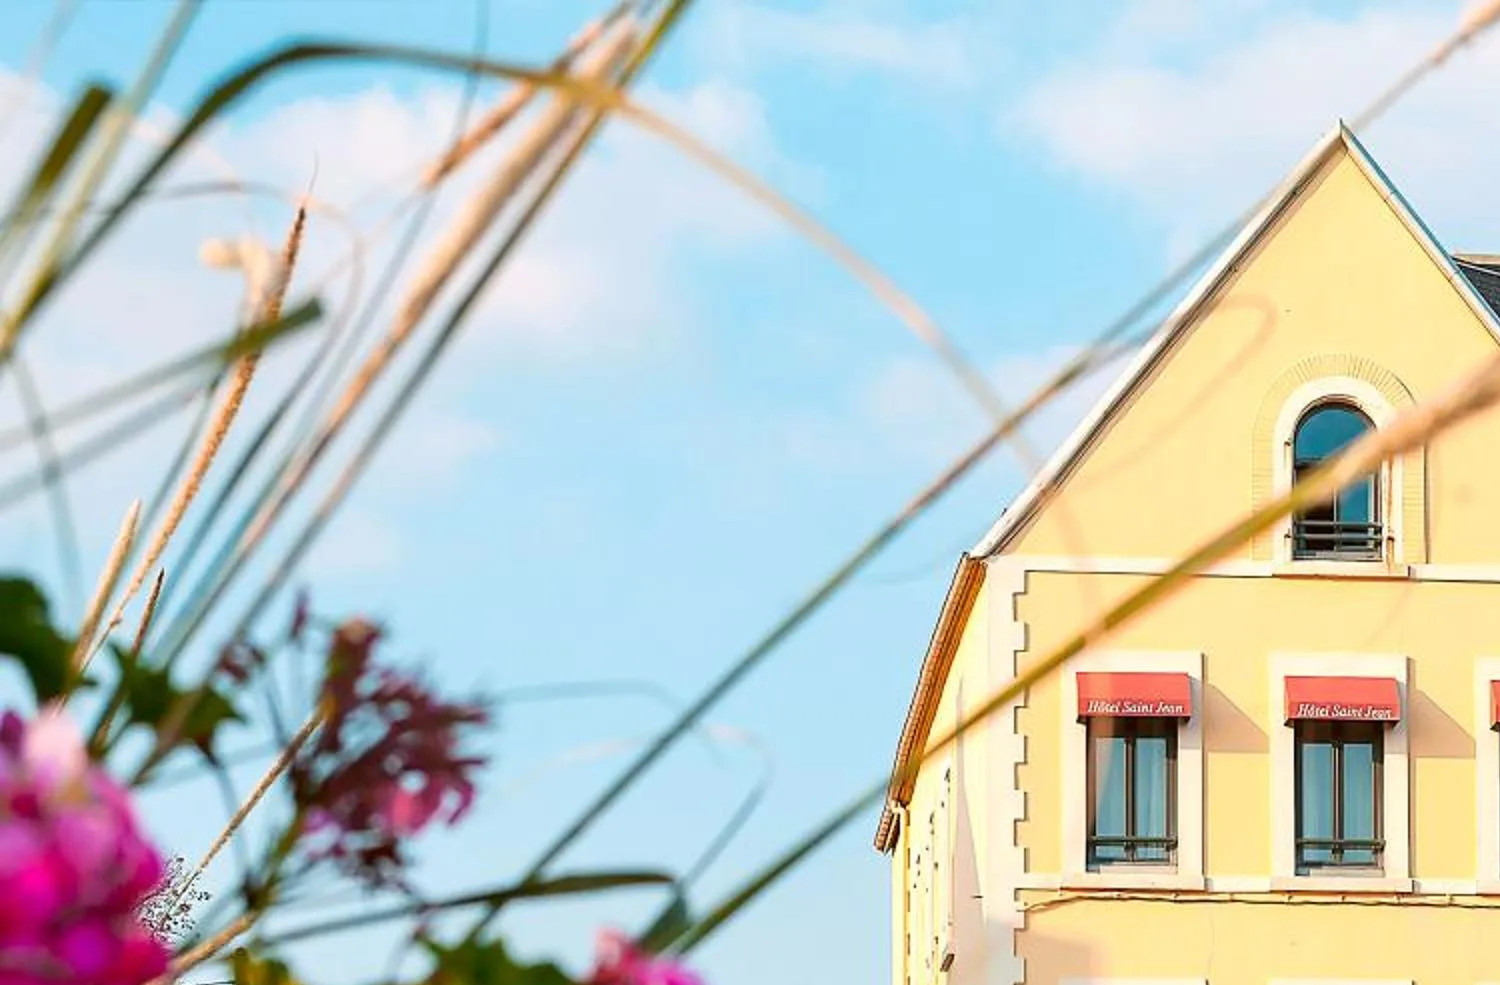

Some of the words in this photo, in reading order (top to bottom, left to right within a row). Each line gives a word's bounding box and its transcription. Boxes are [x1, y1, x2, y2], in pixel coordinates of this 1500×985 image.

[1088, 701, 1119, 713] Hôtel
[1121, 701, 1153, 713] Saint
[1156, 702, 1184, 714] Jean
[1298, 704, 1328, 717] Hôtel
[1331, 704, 1363, 718] Saint
[1364, 706, 1392, 719] Jean
